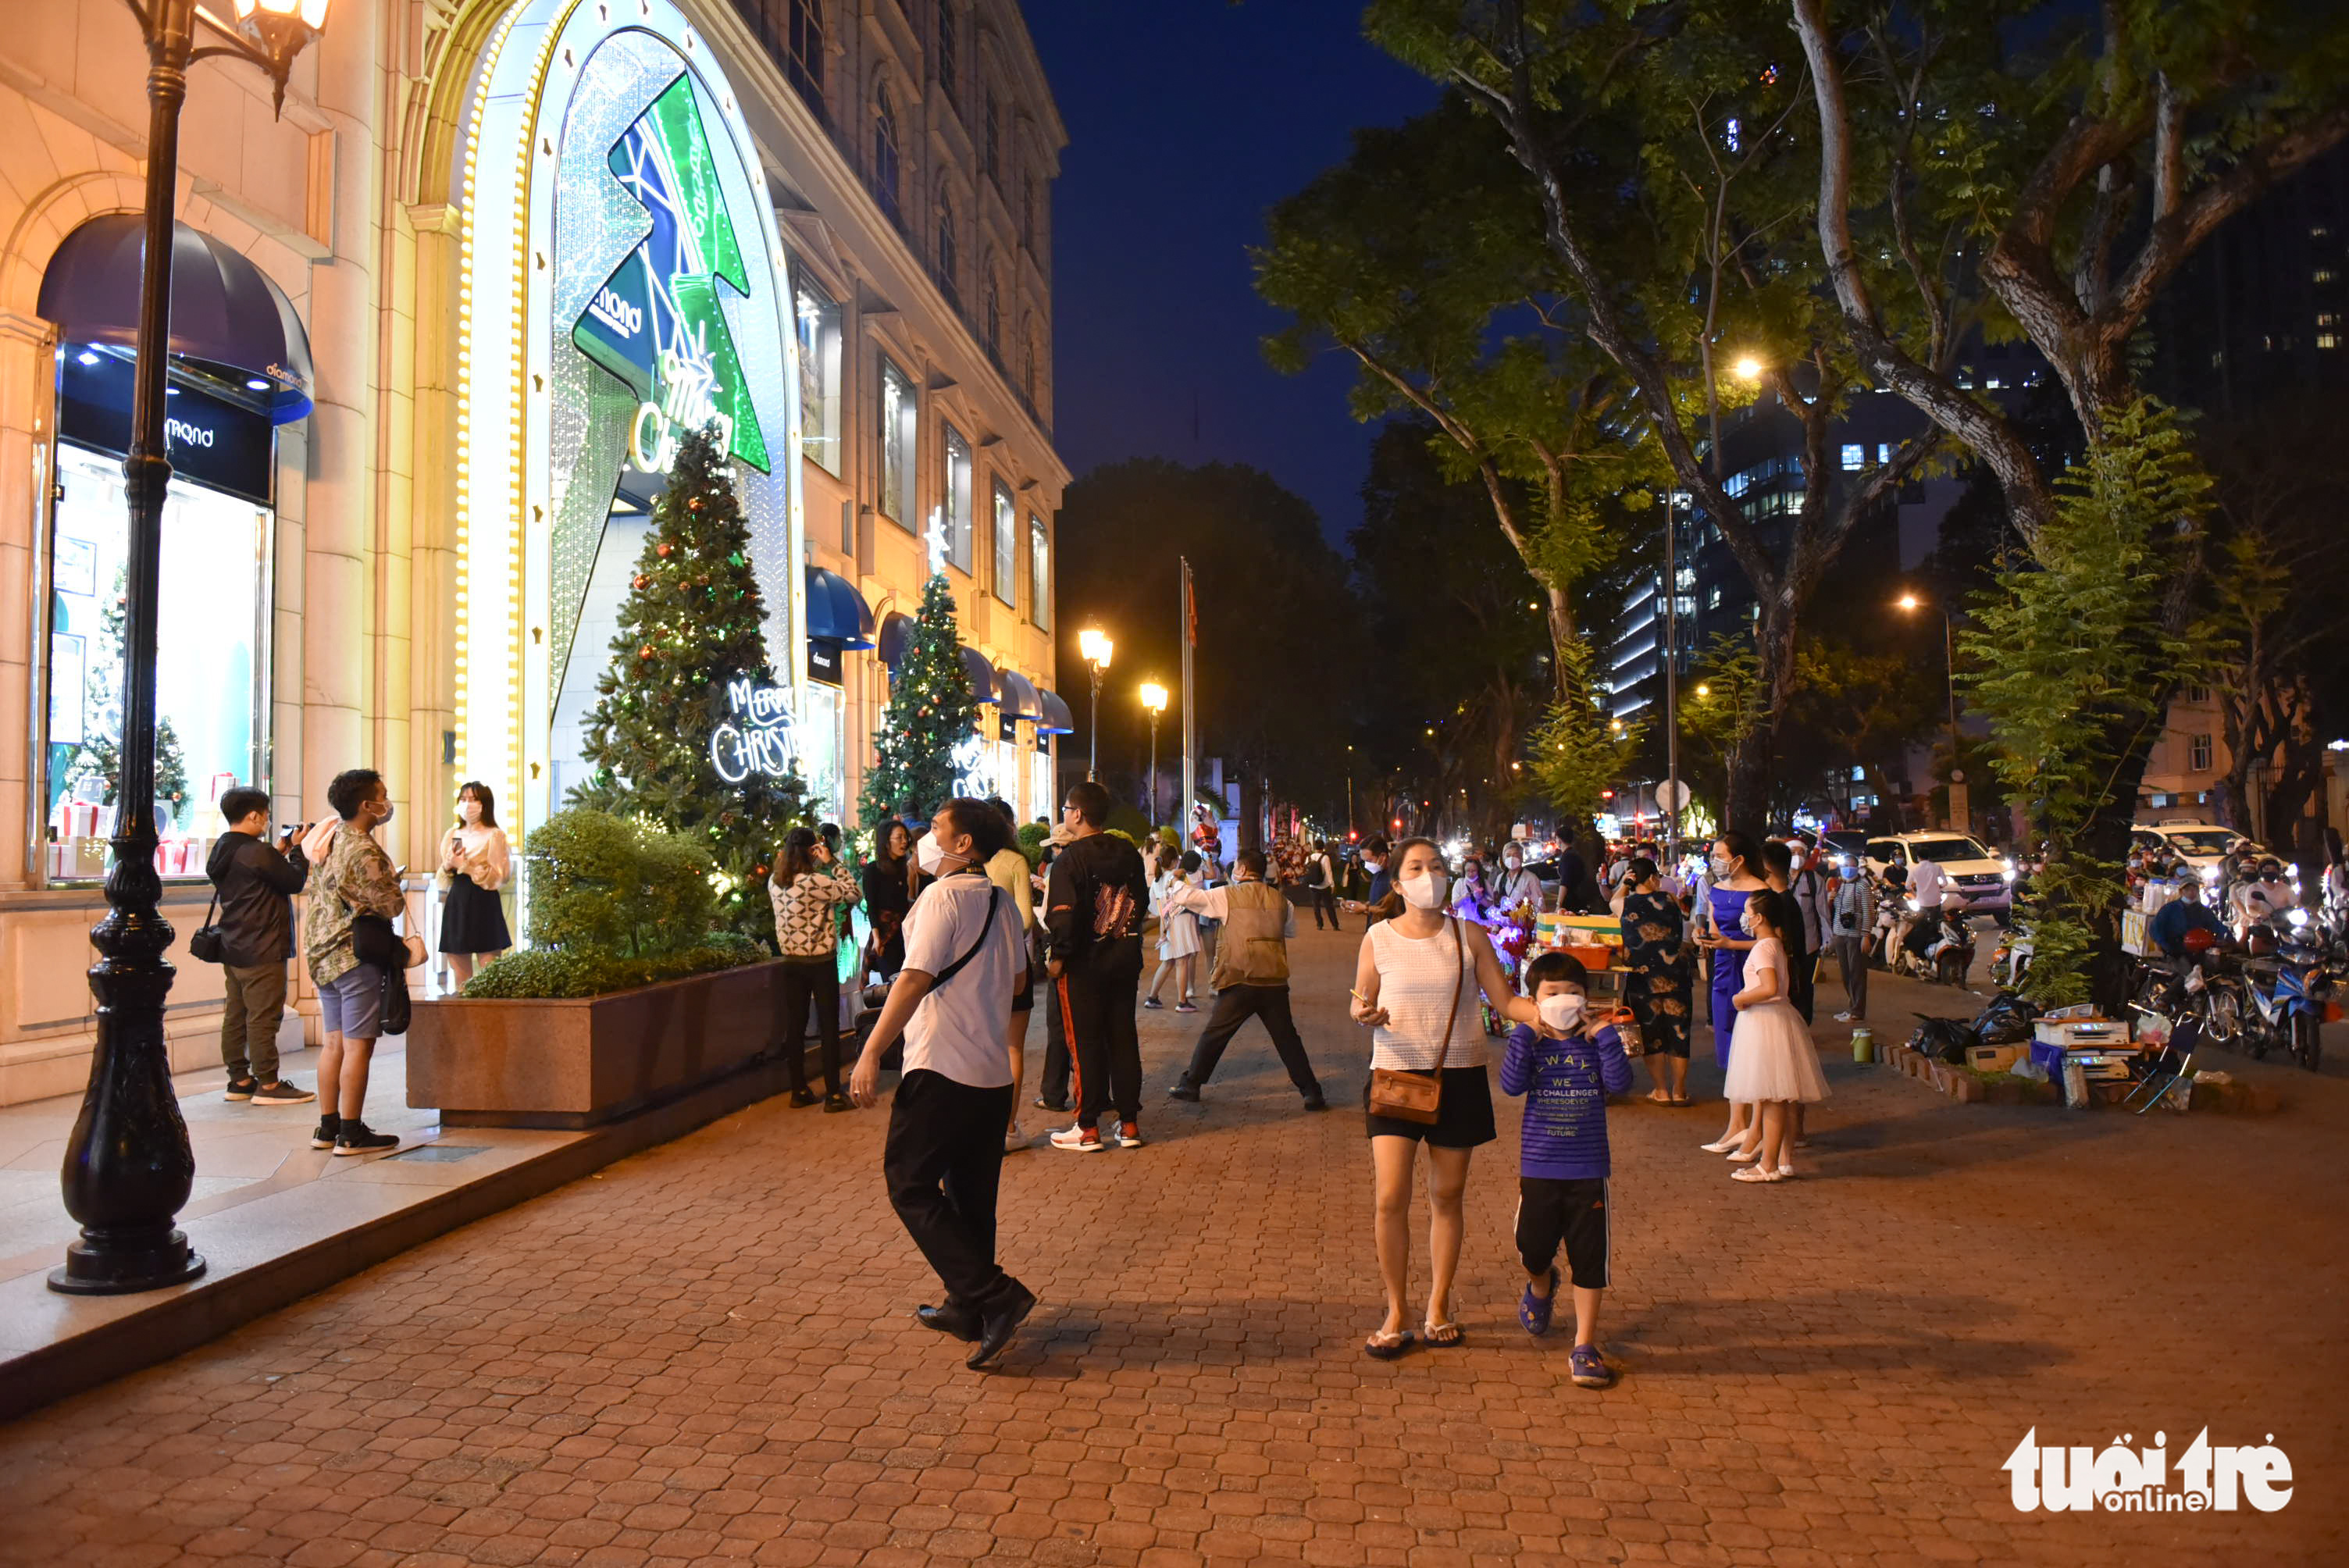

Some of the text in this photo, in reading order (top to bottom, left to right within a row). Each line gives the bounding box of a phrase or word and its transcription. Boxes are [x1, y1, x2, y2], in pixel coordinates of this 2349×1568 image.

[595, 286, 641, 334] mond
[266, 362, 305, 388] diamond
[165, 418, 213, 450] mond
[1552, 1078, 1571, 1087] WE
